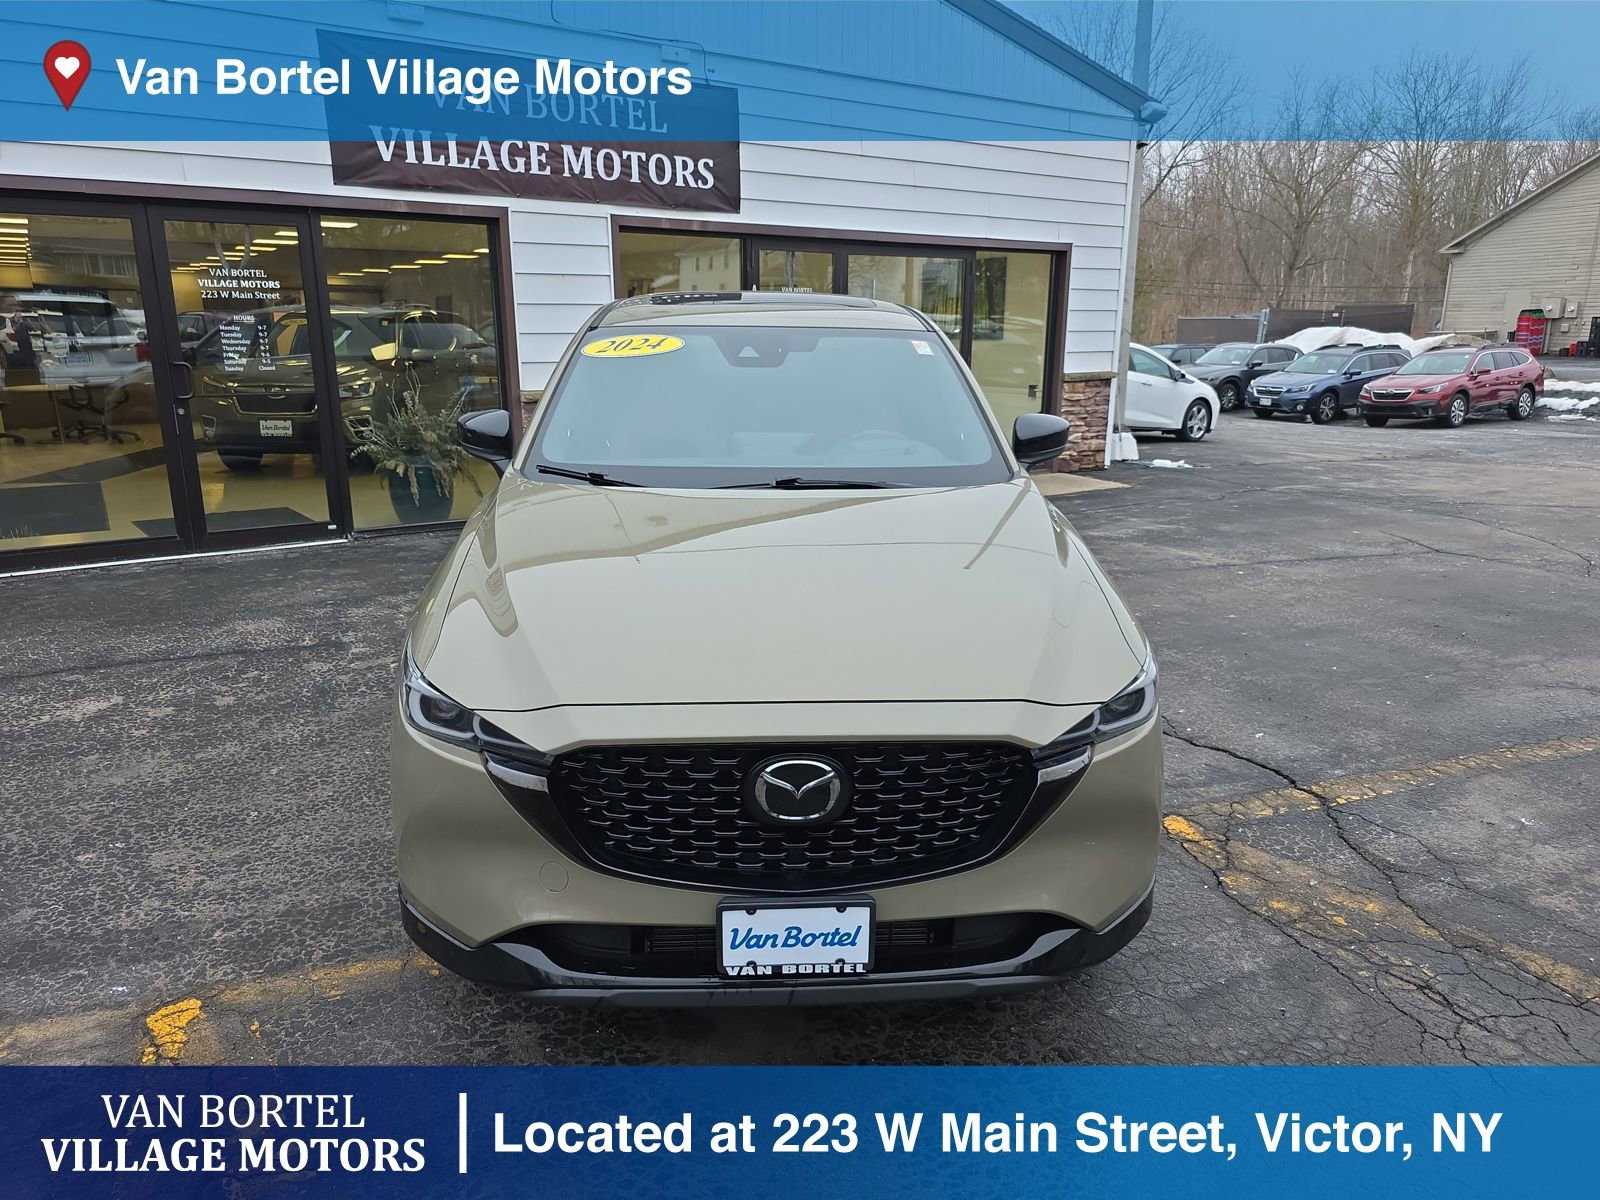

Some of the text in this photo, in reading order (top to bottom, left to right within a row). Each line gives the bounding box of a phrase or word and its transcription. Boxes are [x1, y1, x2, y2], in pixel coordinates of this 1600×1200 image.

[524, 83, 668, 134] BORTEL
[368, 125, 715, 190] VILLAGE MOTORS
[208, 268, 267, 278] VAN BORTEL
[197, 279, 281, 289] VILLAGE MOTORS
[201, 290, 281, 300] 223 W Main Street
[594, 337, 668, 354] 2024
[730, 925, 862, 950] Van Bortel
[725, 963, 867, 976] VAN BORTEL
